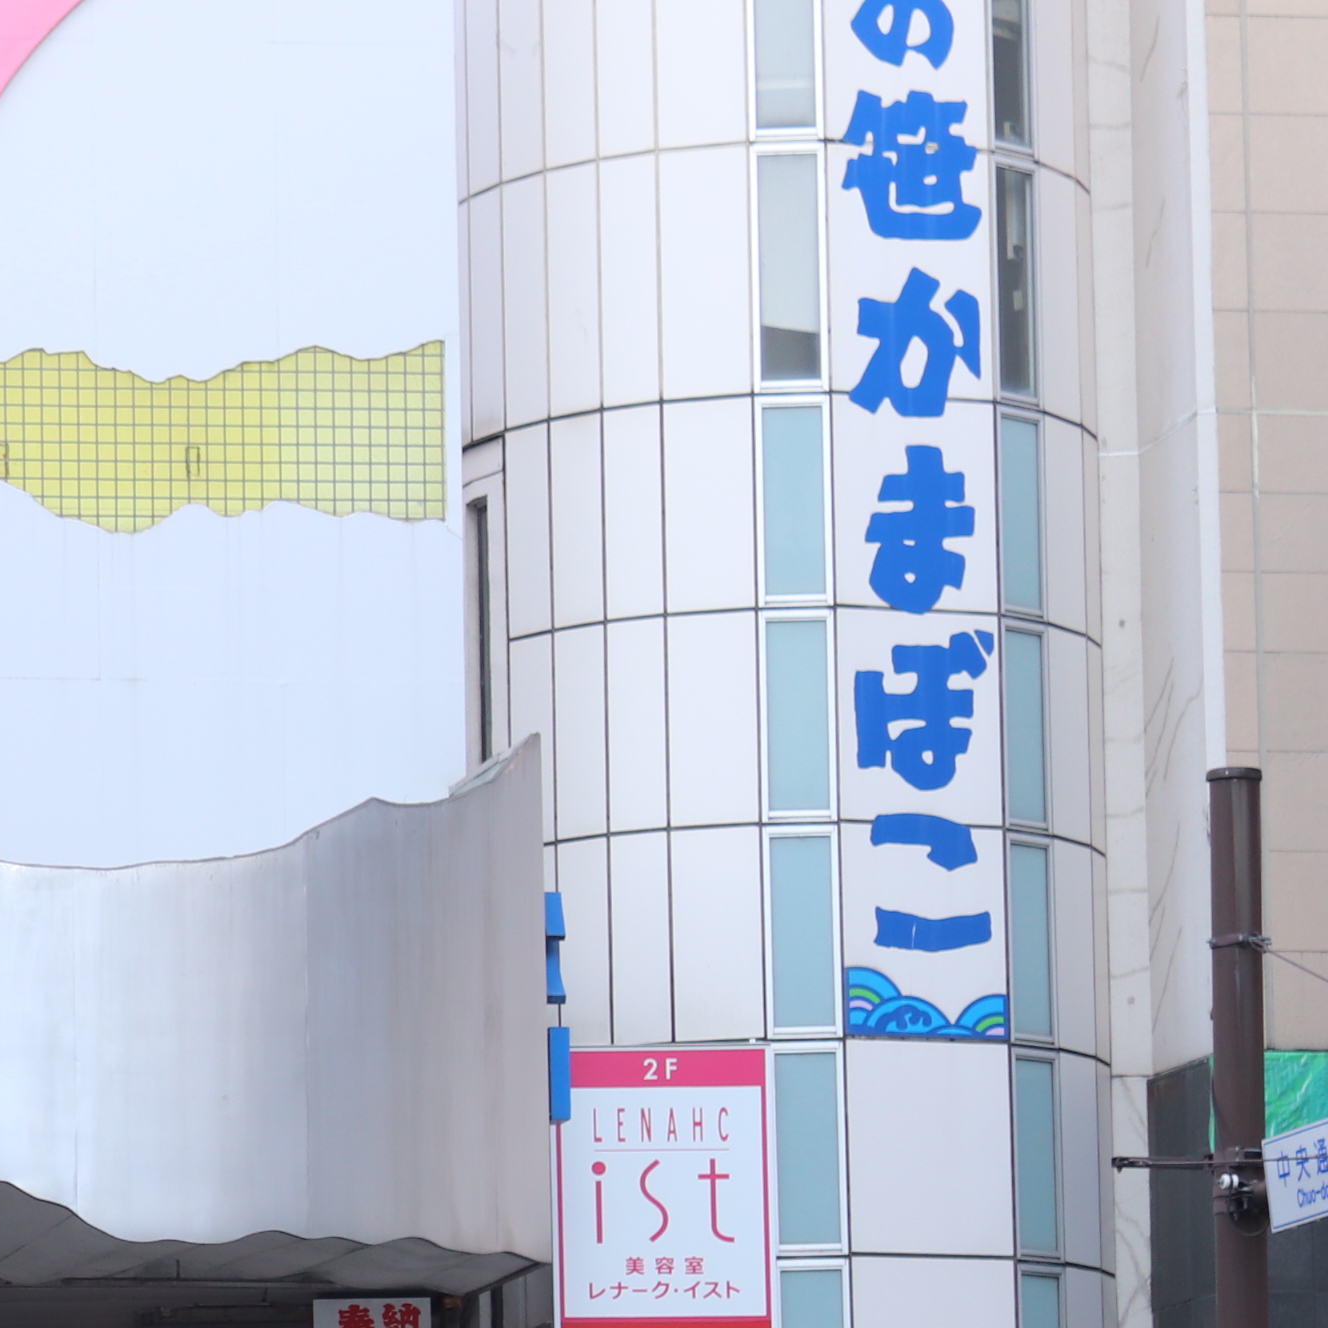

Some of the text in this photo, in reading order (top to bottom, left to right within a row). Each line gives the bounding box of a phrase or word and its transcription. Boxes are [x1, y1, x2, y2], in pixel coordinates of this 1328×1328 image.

[642, 1057, 679, 1081] 2F
[592, 1106, 731, 1143] LENAHC
[625, 1256, 705, 1276] 美容室
[589, 1279, 741, 1300] レナーク・イスト
